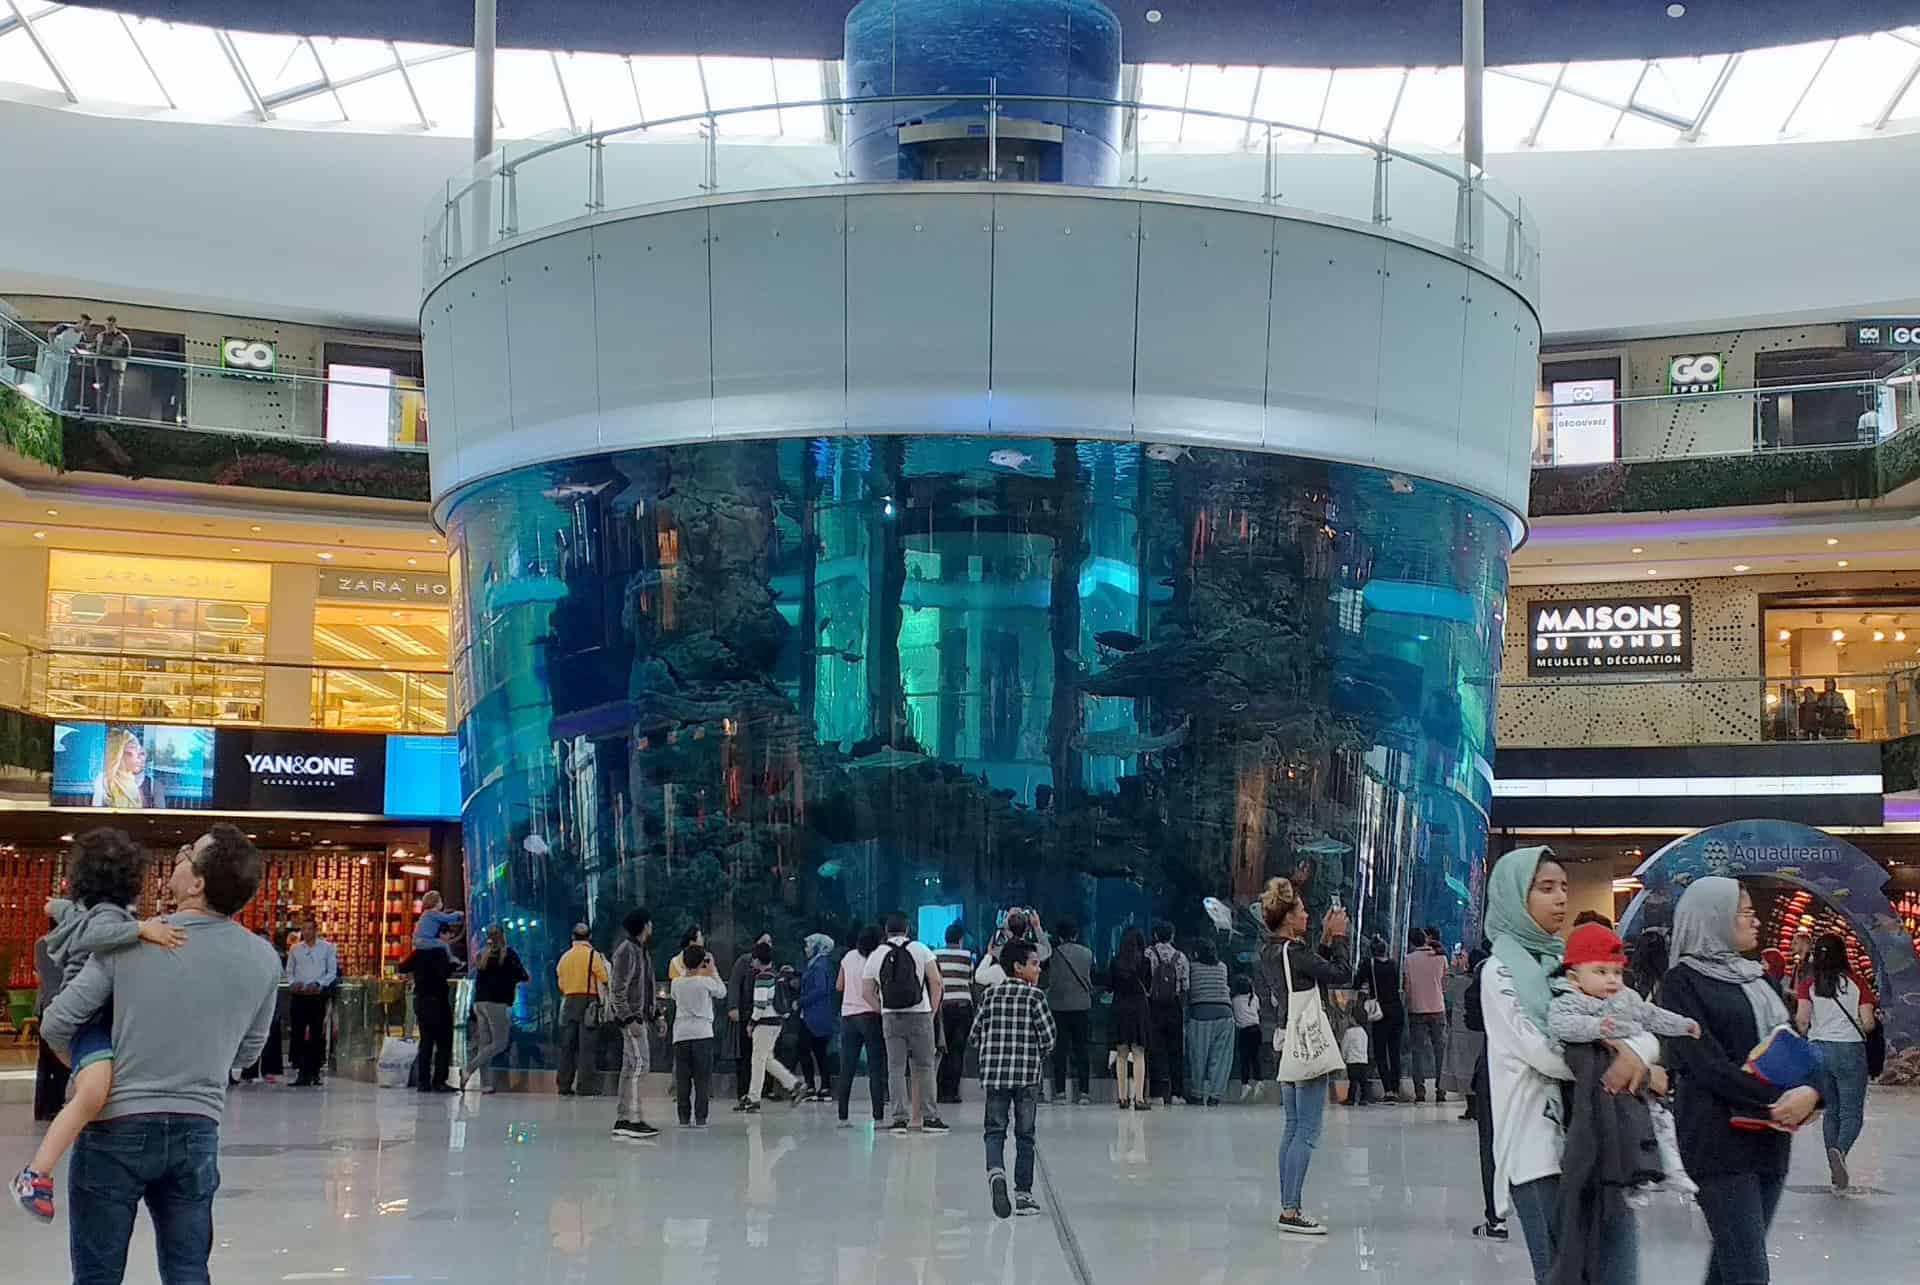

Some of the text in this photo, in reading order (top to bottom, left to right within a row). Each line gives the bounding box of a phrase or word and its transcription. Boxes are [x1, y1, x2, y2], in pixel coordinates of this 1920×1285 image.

[224, 341, 272, 367] GO
[1672, 356, 1720, 382] GO
[1575, 389, 1593, 401] GO
[338, 578, 447, 595] ZARA HO
[1537, 604, 1681, 631] MAISONS
[1536, 634, 1681, 650] DU MONDE
[1536, 656, 1588, 667] MEUBLES
[1607, 654, 1681, 666] DÉCORATION
[244, 754, 354, 776] YAN&ONE
[1734, 843, 1840, 863] Aquadream
